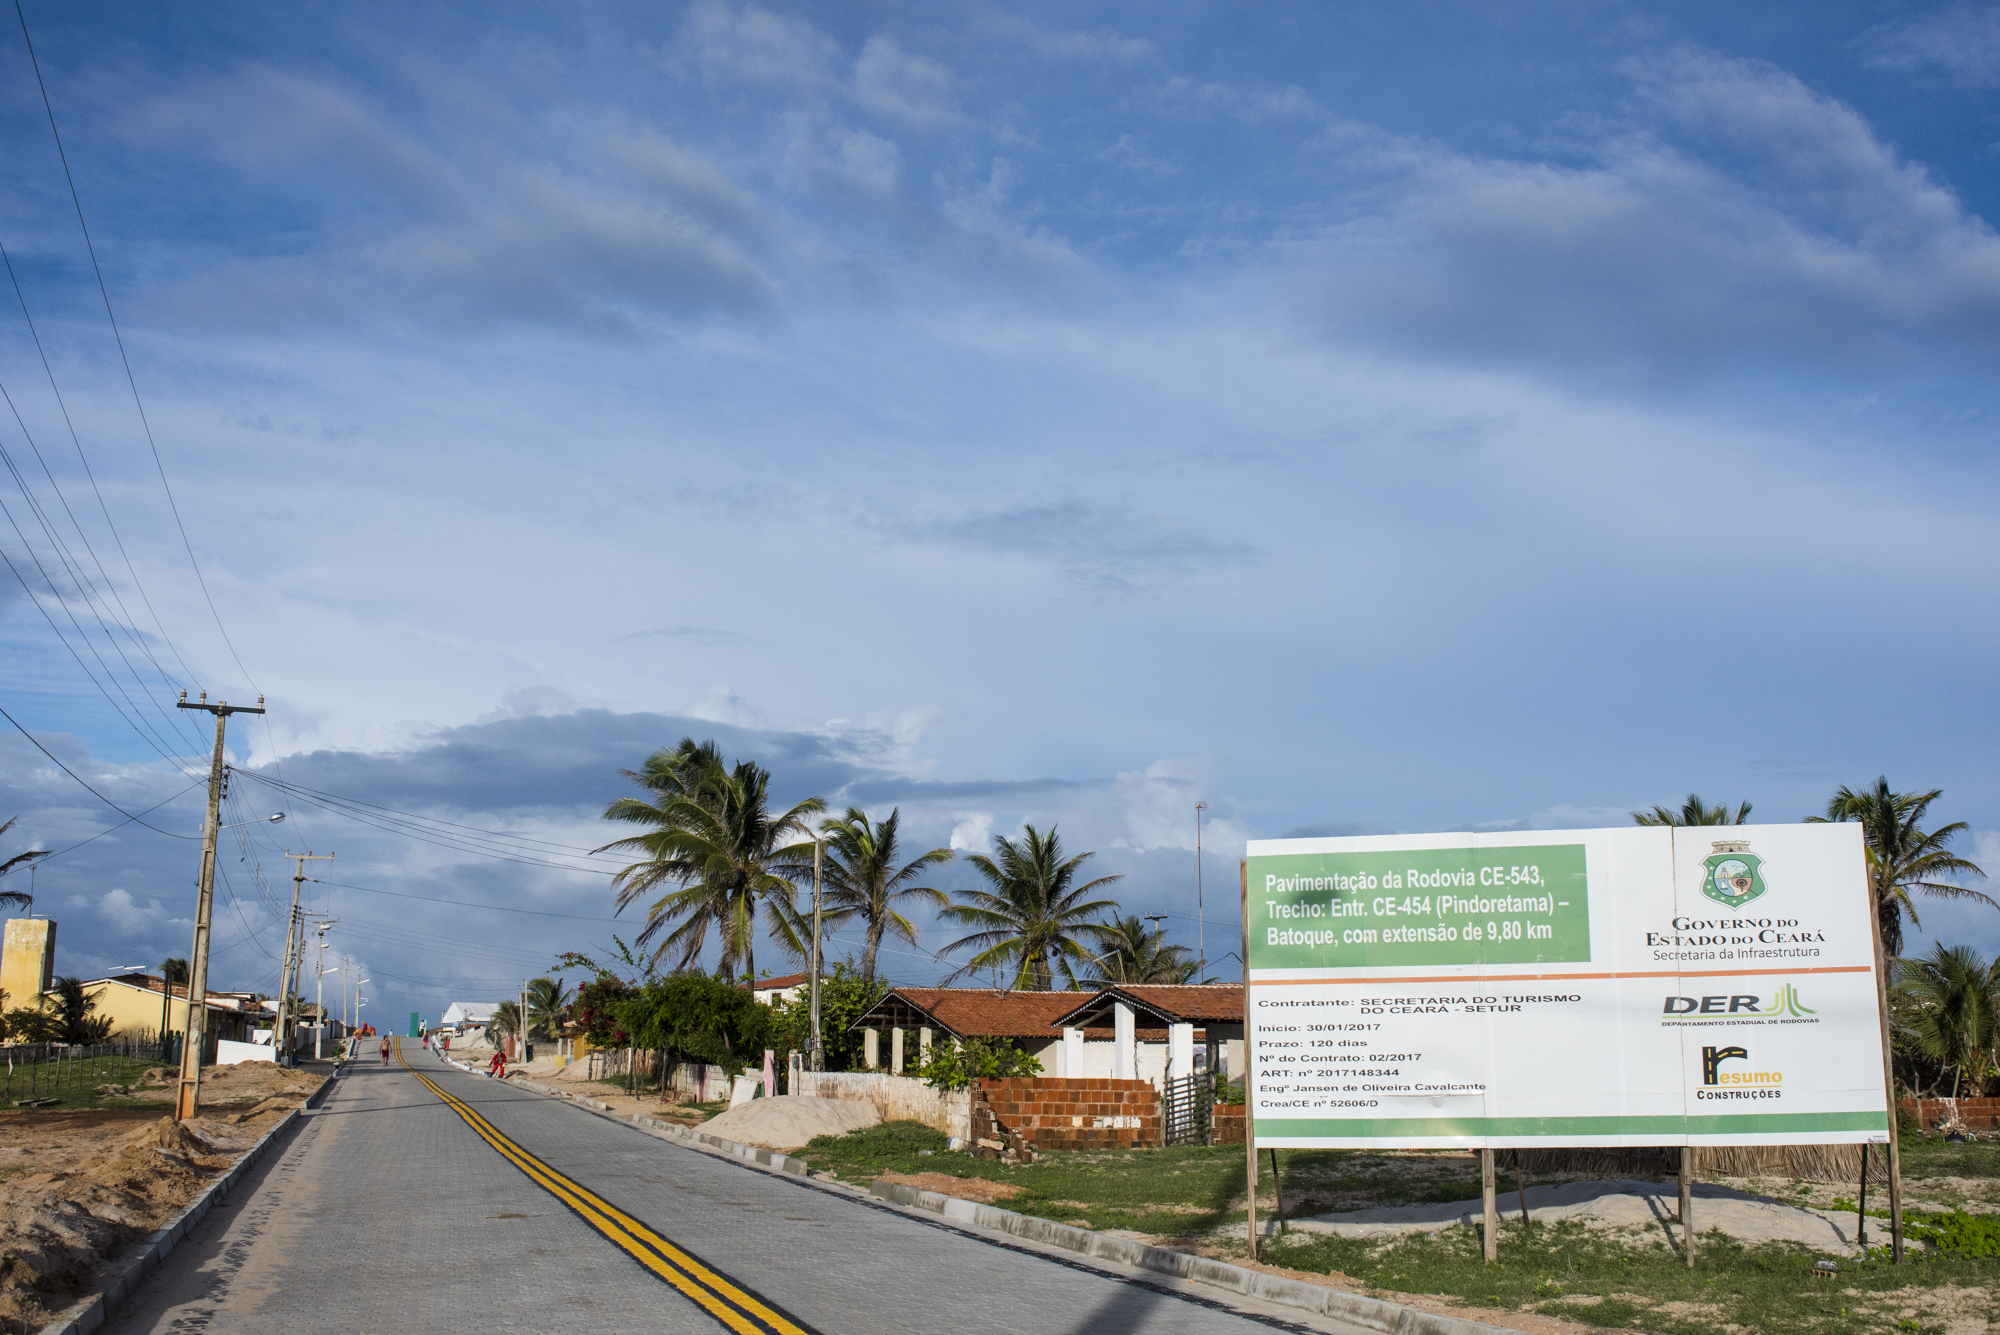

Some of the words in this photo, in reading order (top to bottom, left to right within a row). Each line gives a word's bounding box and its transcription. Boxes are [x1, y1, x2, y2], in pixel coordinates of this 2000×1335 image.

[1265, 871, 1378, 894] Pavimentação
[1382, 869, 1402, 888] da
[1407, 868, 1475, 888] Rodovia
[1480, 865, 1545, 888] CE-543,
[1266, 899, 1325, 919] Trecho:
[1331, 898, 1368, 917] Entr.
[1373, 896, 1432, 916] CE-454
[1436, 892, 1554, 919] (Pindoretama)
[1672, 917, 1772, 931] GOVERNO
[1777, 918, 1799, 928] DO
[1267, 926, 1338, 949] Batoque,
[1343, 927, 1378, 944] com
[1382, 923, 1457, 943] extensão
[1462, 921, 1482, 941] de
[1487, 921, 1522, 944] 9,80
[1526, 920, 1553, 939] km
[1645, 932, 1727, 947] ESTADO
[1731, 935, 1753, 945] DO
[1758, 929, 1826, 944] CEARÁ
[1653, 949, 1715, 961] Secretaria
[1719, 948, 1734, 960] da
[1737, 947, 1820, 959] Infraestrutura
[1258, 999, 1355, 1008] Contratante:
[1360, 996, 1467, 1006] SECRETARIA
[1473, 996, 1497, 1004] DO
[1502, 994, 1581, 1003] TURISMO
[1662, 995, 1762, 1014] DER
[1360, 1006, 1384, 1014] DO
[1390, 1004, 1450, 1014] CEARÁ
[1464, 1004, 1522, 1013] SETUR
[1306, 1023, 1381, 1032] 30/01/2017
[1258, 1040, 1304, 1048] Prazo:
[1309, 1039, 1333, 1047] 120
[1338, 1039, 1368, 1047] dias
[1278, 1054, 1296, 1062] do
[1300, 1054, 1365, 1062] Contrato:
[1369, 1053, 1422, 1062] 02/2017
[1260, 1069, 1293, 1077] ART:
[1317, 1068, 1400, 1077] 2017148344
[1293, 1084, 1338, 1092] Jansen
[1342, 1084, 1358, 1092] de
[1362, 1083, 1411, 1092] Oliveira
[1415, 1082, 1487, 1091] Cavalcante
[1697, 1089, 1782, 1101] CONSTRUÇÕES
[1260, 1099, 1310, 1108] Crea/CE
[1330, 1099, 1378, 1108] 52606/D
